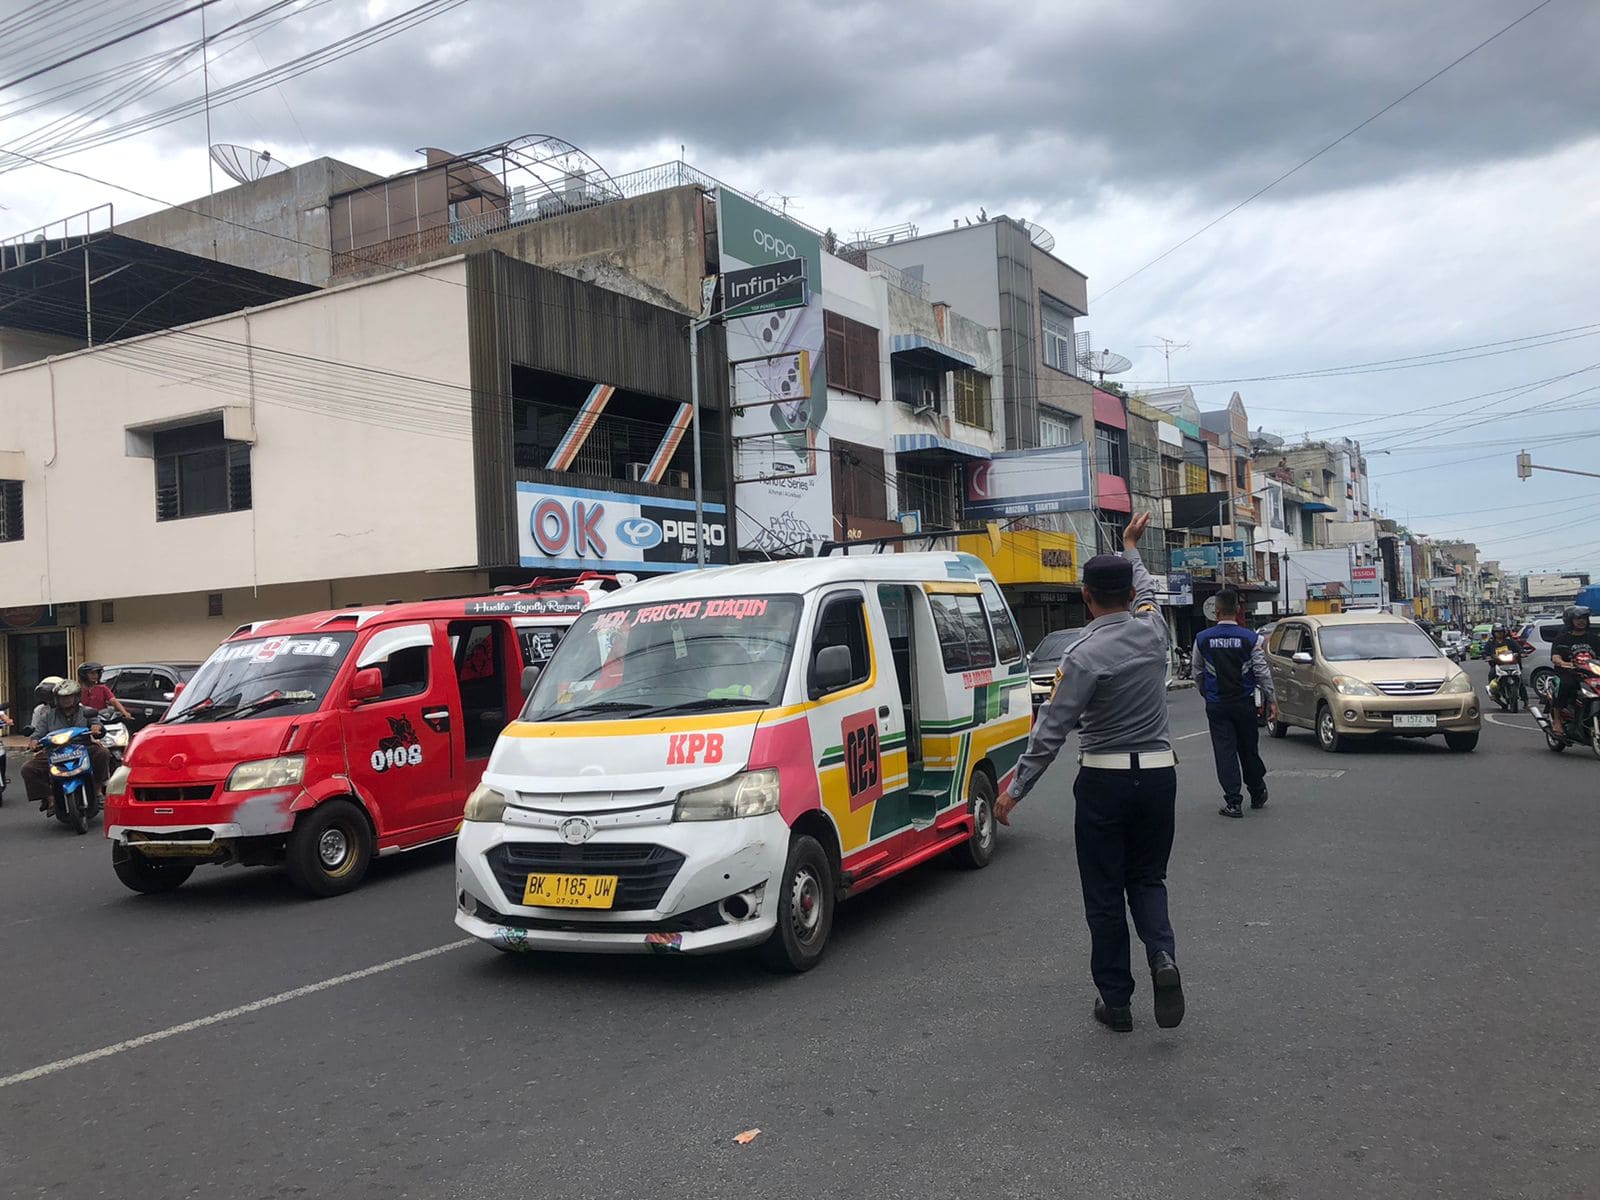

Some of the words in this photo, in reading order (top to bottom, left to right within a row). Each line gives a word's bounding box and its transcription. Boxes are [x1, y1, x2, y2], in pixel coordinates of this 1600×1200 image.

[753, 229, 796, 259] oppo
[731, 273, 794, 298] Infinix
[787, 478, 809, 491] Series
[531, 497, 607, 558] OK
[662, 519, 726, 547] PIERO
[770, 516, 811, 533] PHOTO
[631, 601, 702, 628] JERICHO
[1210, 637, 1241, 648] DISHUB
[371, 744, 422, 771] 0108
[666, 733, 723, 765] KPB
[847, 723, 877, 797] 029
[529, 876, 546, 894] BK
[556, 877, 587, 896] 1185
[594, 879, 613, 896] UW
